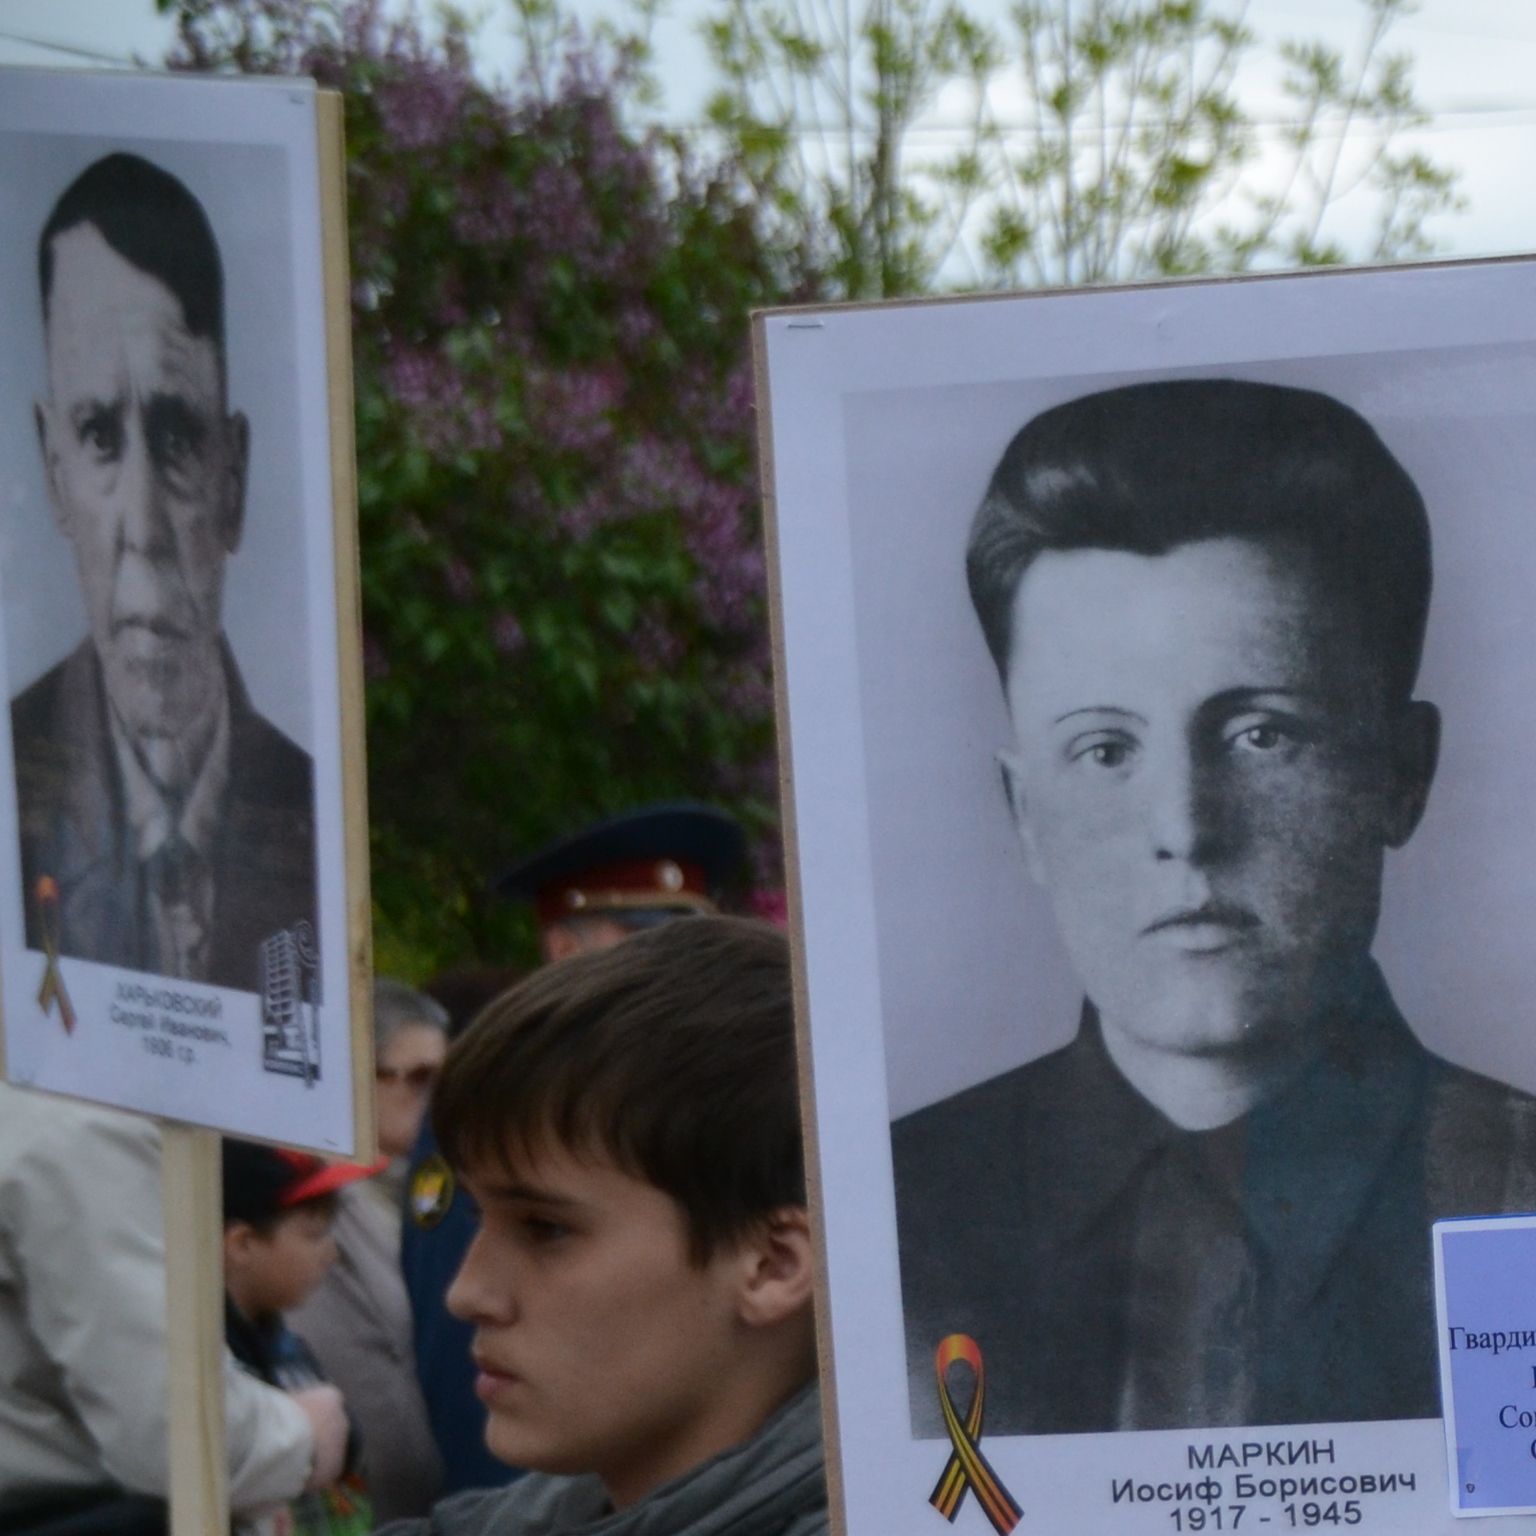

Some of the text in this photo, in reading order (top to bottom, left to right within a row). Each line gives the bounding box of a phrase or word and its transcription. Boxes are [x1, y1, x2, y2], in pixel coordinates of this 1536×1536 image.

[1187, 1440, 1335, 1469] МАРКИН
[1111, 1472, 1417, 1506] Иосиф Борисович
[1169, 1505, 1245, 1532] 1917
[1284, 1501, 1363, 1528] 1945
